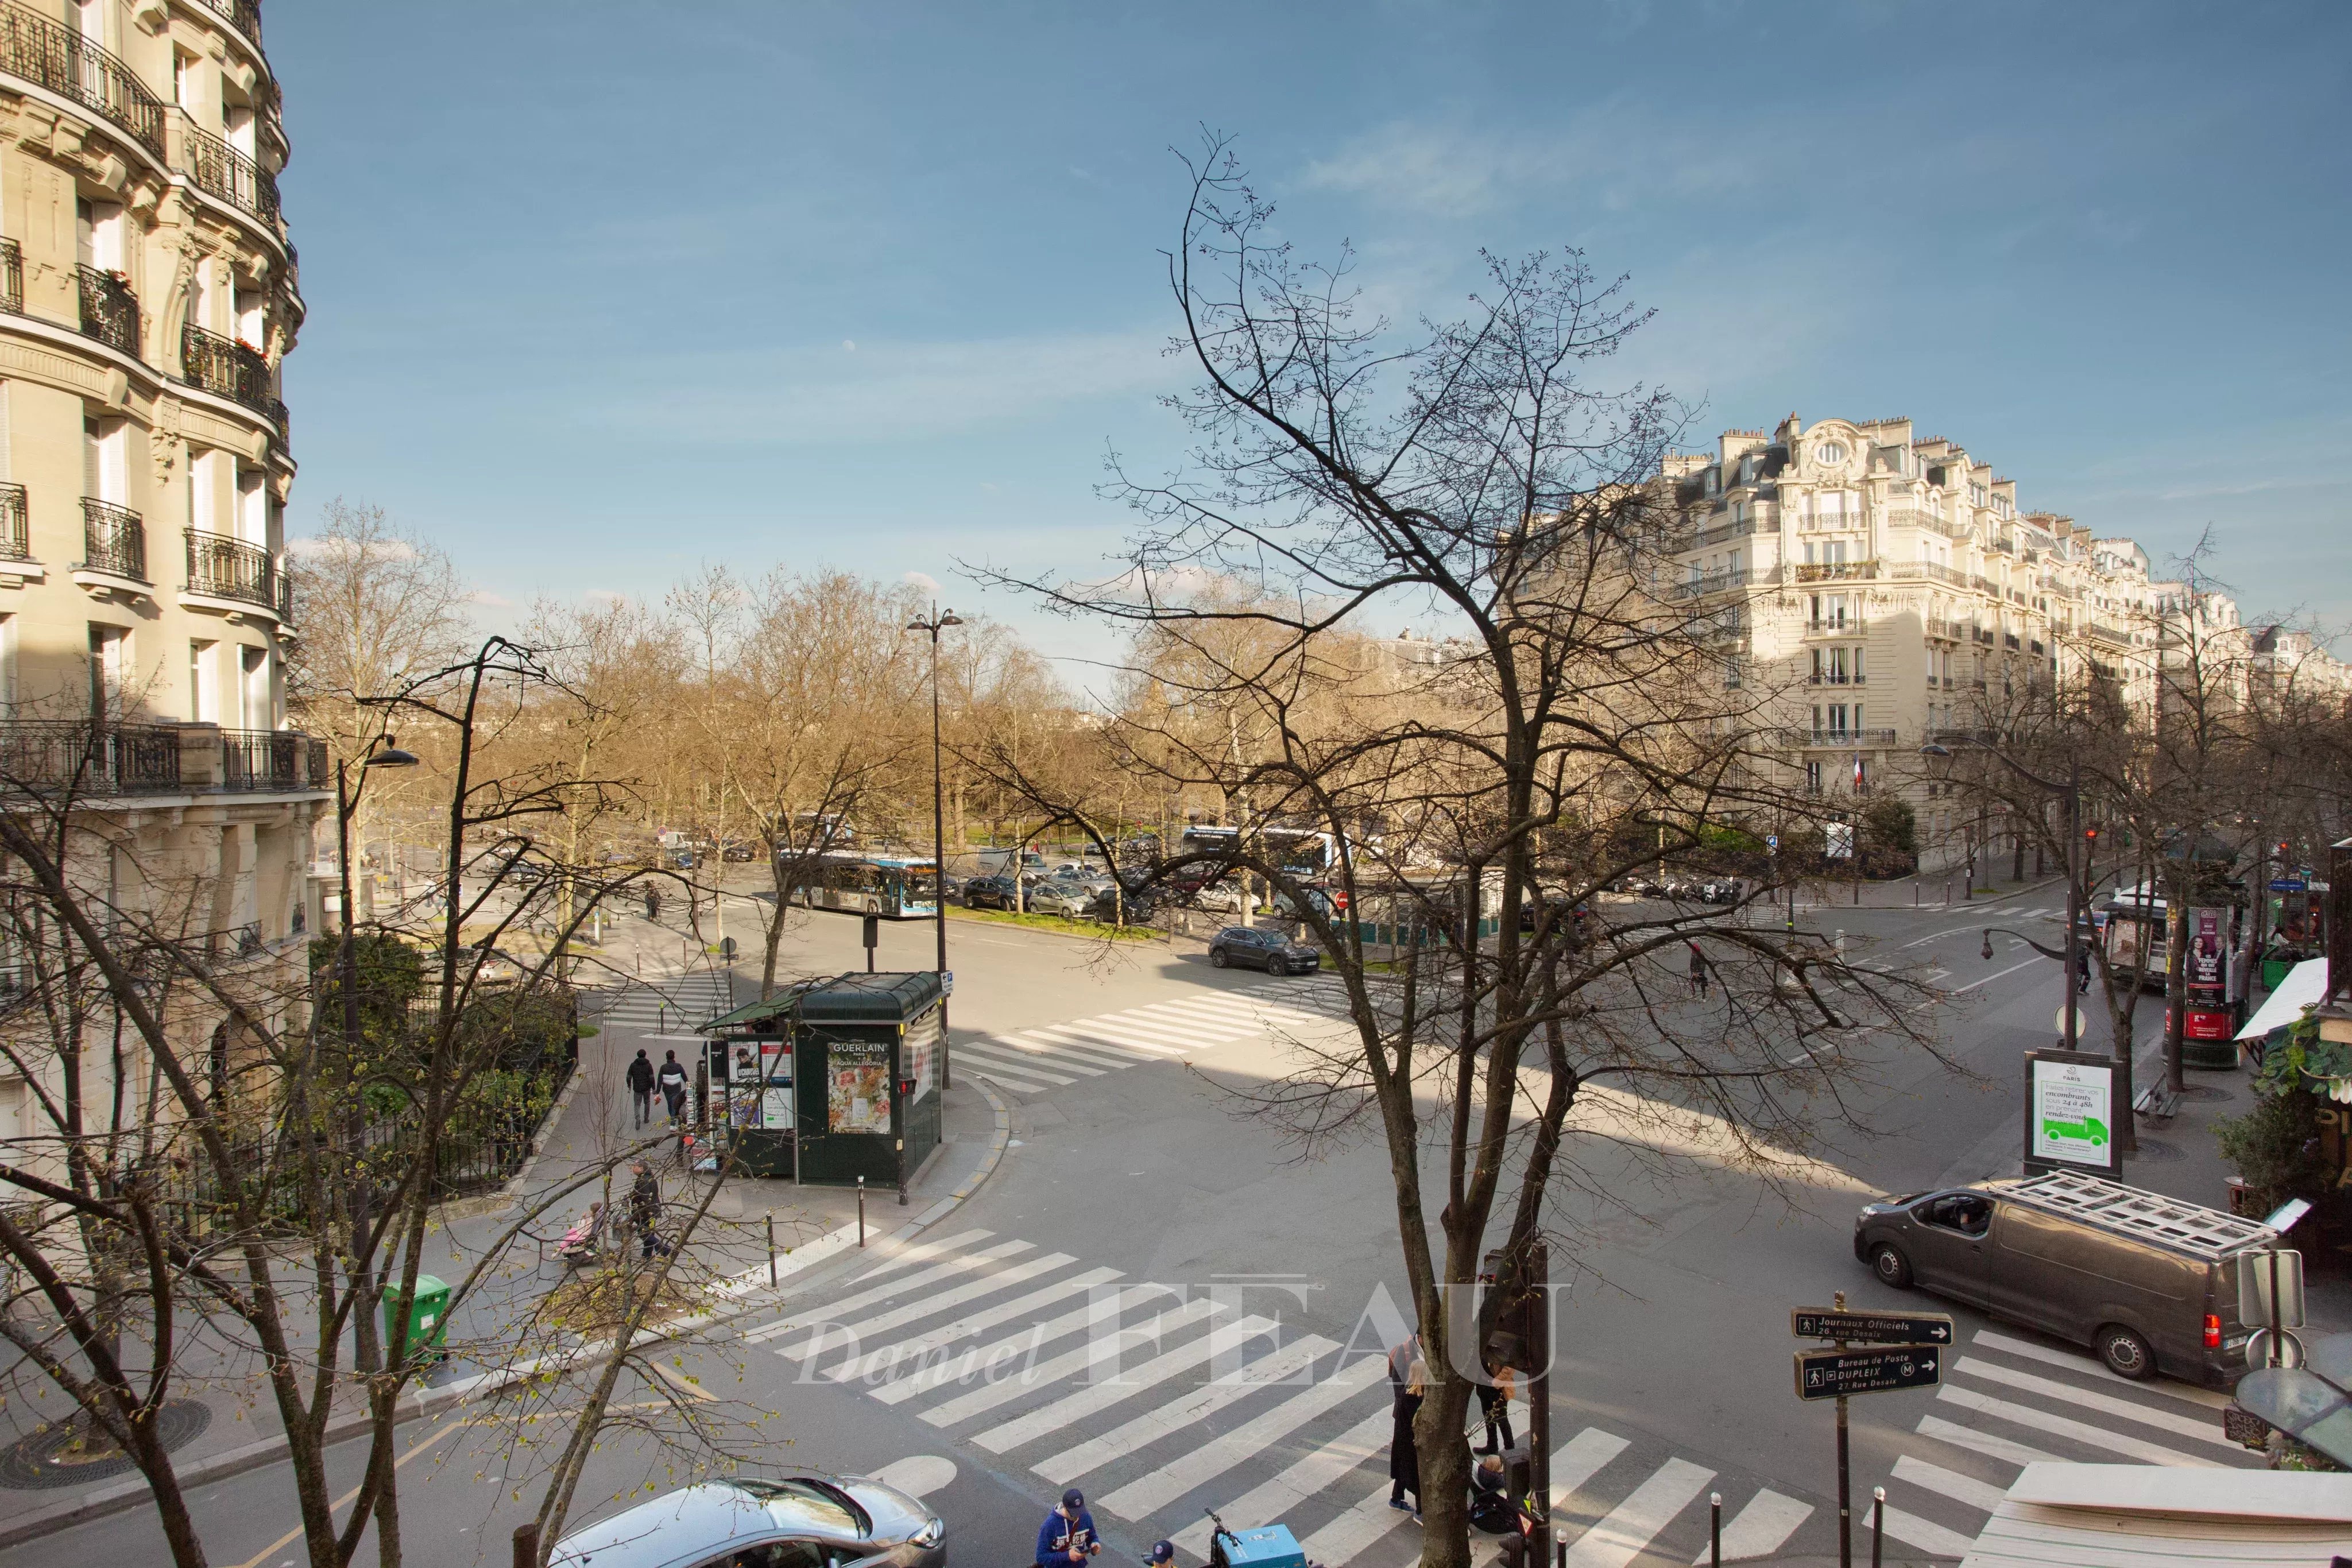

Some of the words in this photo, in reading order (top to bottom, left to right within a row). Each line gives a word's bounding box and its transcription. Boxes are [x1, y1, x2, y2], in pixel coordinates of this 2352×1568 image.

[833, 1044, 884, 1052] GUERLAIN
[2045, 1091, 2091, 1101] encombrants
[2045, 1111, 2087, 1121] rendez-vous
[1819, 1317, 1863, 1328] Journaux
[1867, 1321, 1910, 1331] Officiels
[1853, 1330, 1882, 1338] Desaix
[1838, 1358, 1869, 1368] Bureau
[1871, 1356, 1882, 1365] de
[1885, 1354, 1909, 1364] Poste
[1838, 1368, 1881, 1380] DUPLEIX
[1851, 1381, 1867, 1389] Rue
[1870, 1378, 1897, 1387] Desaix
